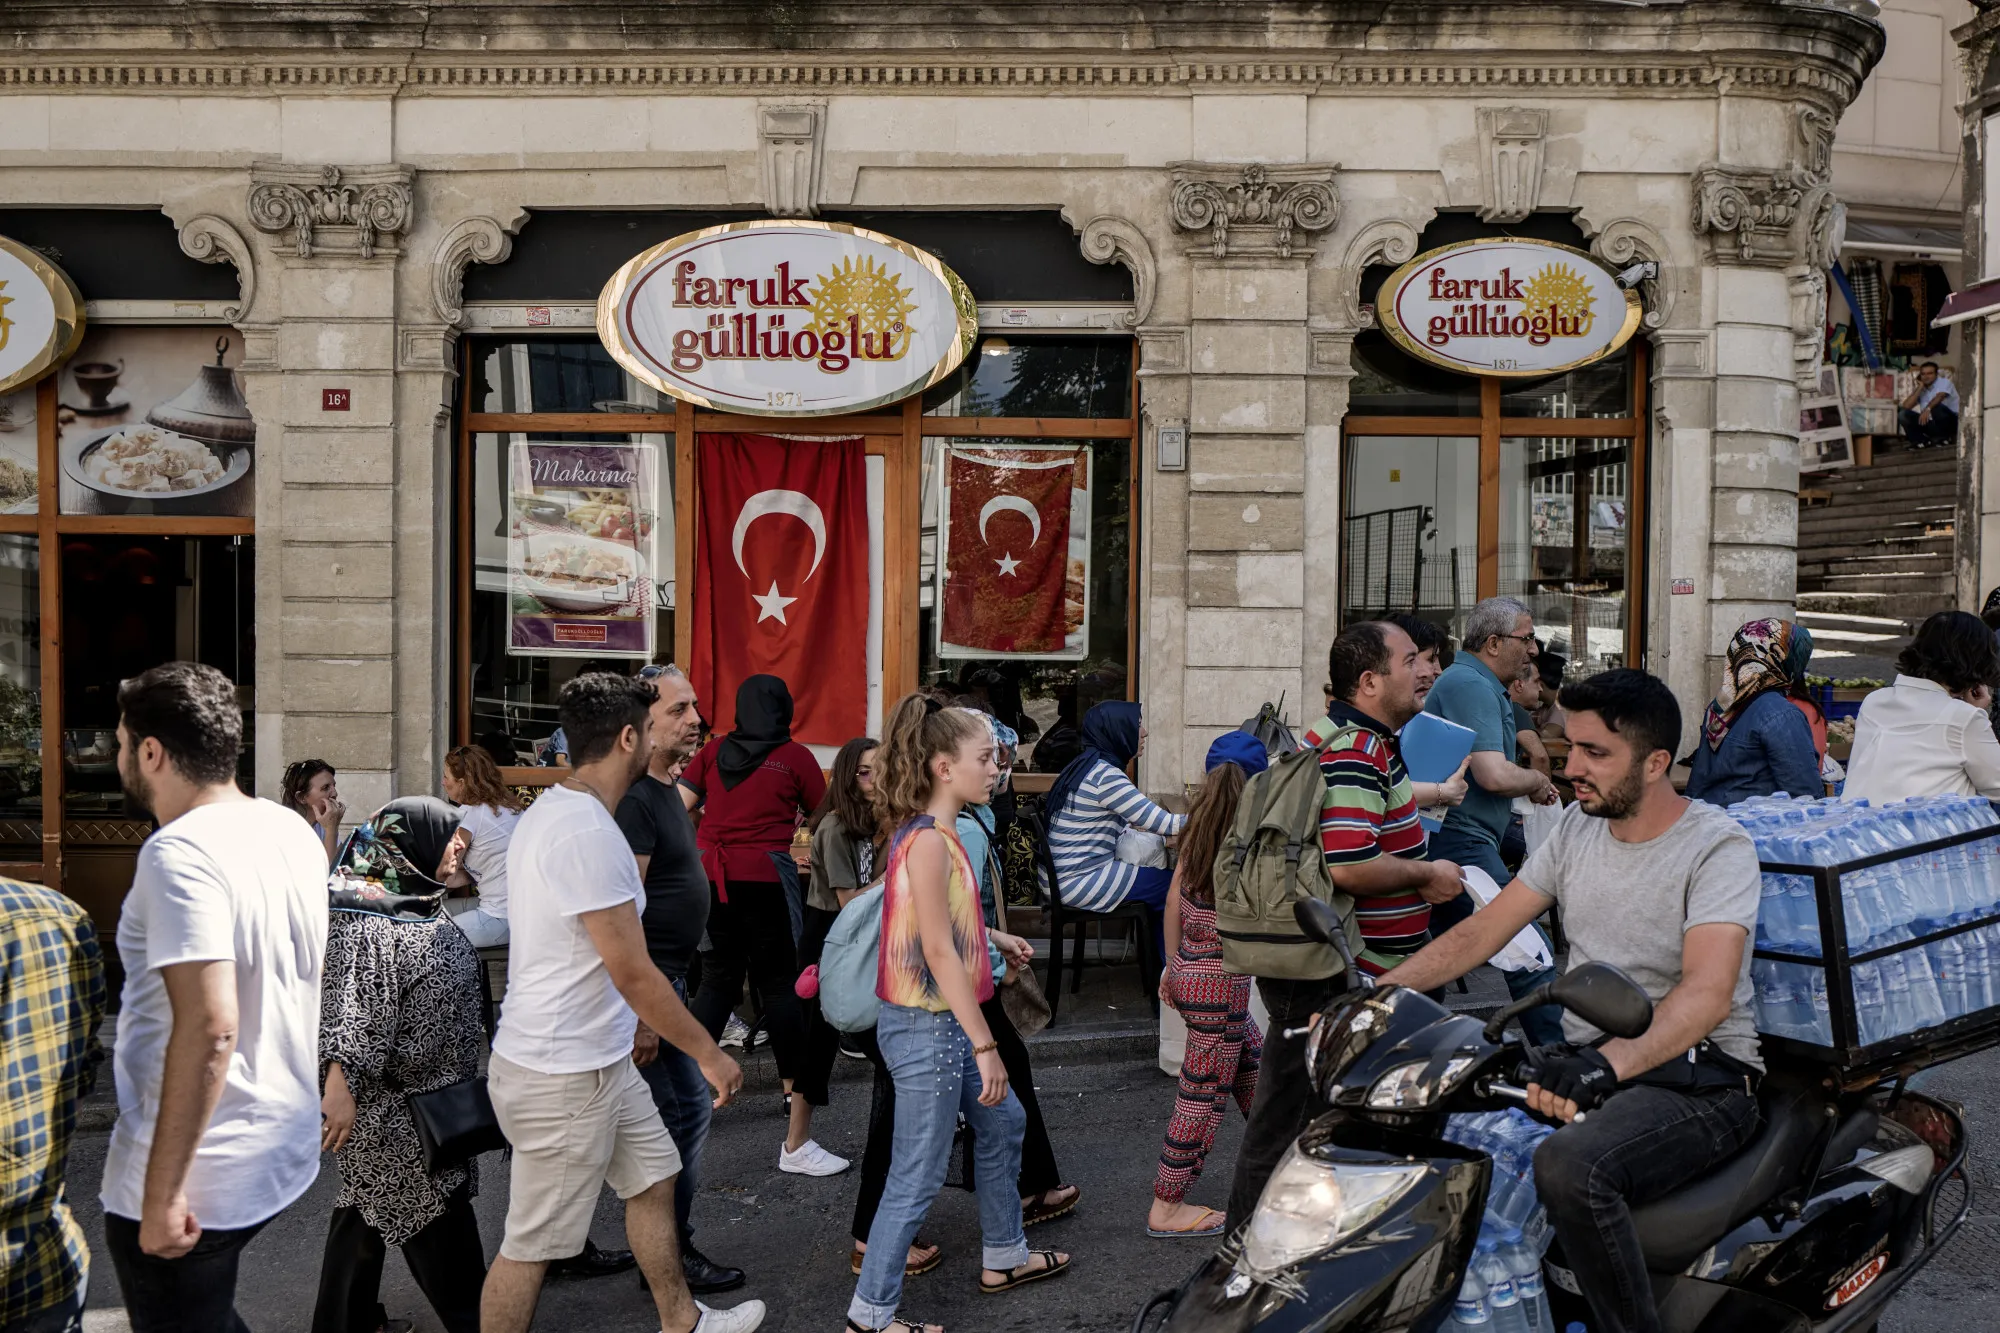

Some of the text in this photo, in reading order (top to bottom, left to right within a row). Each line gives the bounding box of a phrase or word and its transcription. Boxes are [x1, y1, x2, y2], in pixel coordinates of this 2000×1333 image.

[672, 260, 811, 308] faruk
[1428, 267, 1525, 301] faruk
[1427, 304, 1582, 346] güllüoğlu
[671, 312, 894, 374] güllüoğlu
[1493, 359, 1518, 370] 1871
[328, 393, 347, 406] 16A
[767, 392, 803, 406] 1871
[530, 458, 638, 484] Makarna
